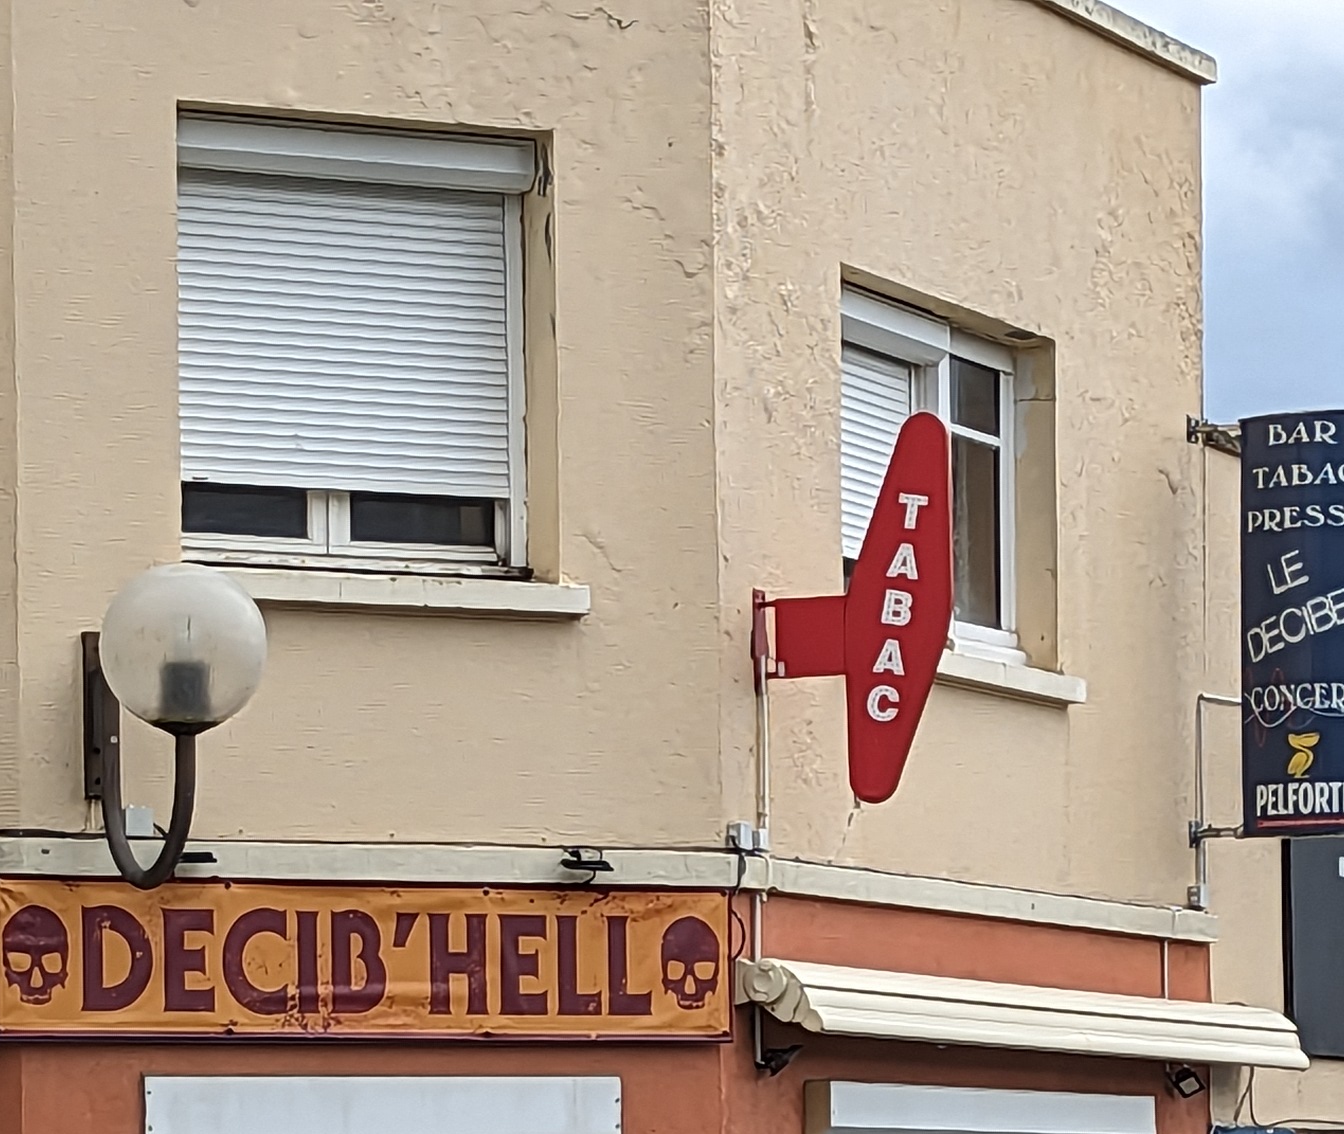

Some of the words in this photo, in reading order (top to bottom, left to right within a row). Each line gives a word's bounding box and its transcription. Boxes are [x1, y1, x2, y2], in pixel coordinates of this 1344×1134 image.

[1268, 420, 1338, 446] BAR
[867, 493, 929, 722] TABAC
[1267, 549, 1310, 595] LE
[80, 903, 654, 1017] DECIB'HELL
